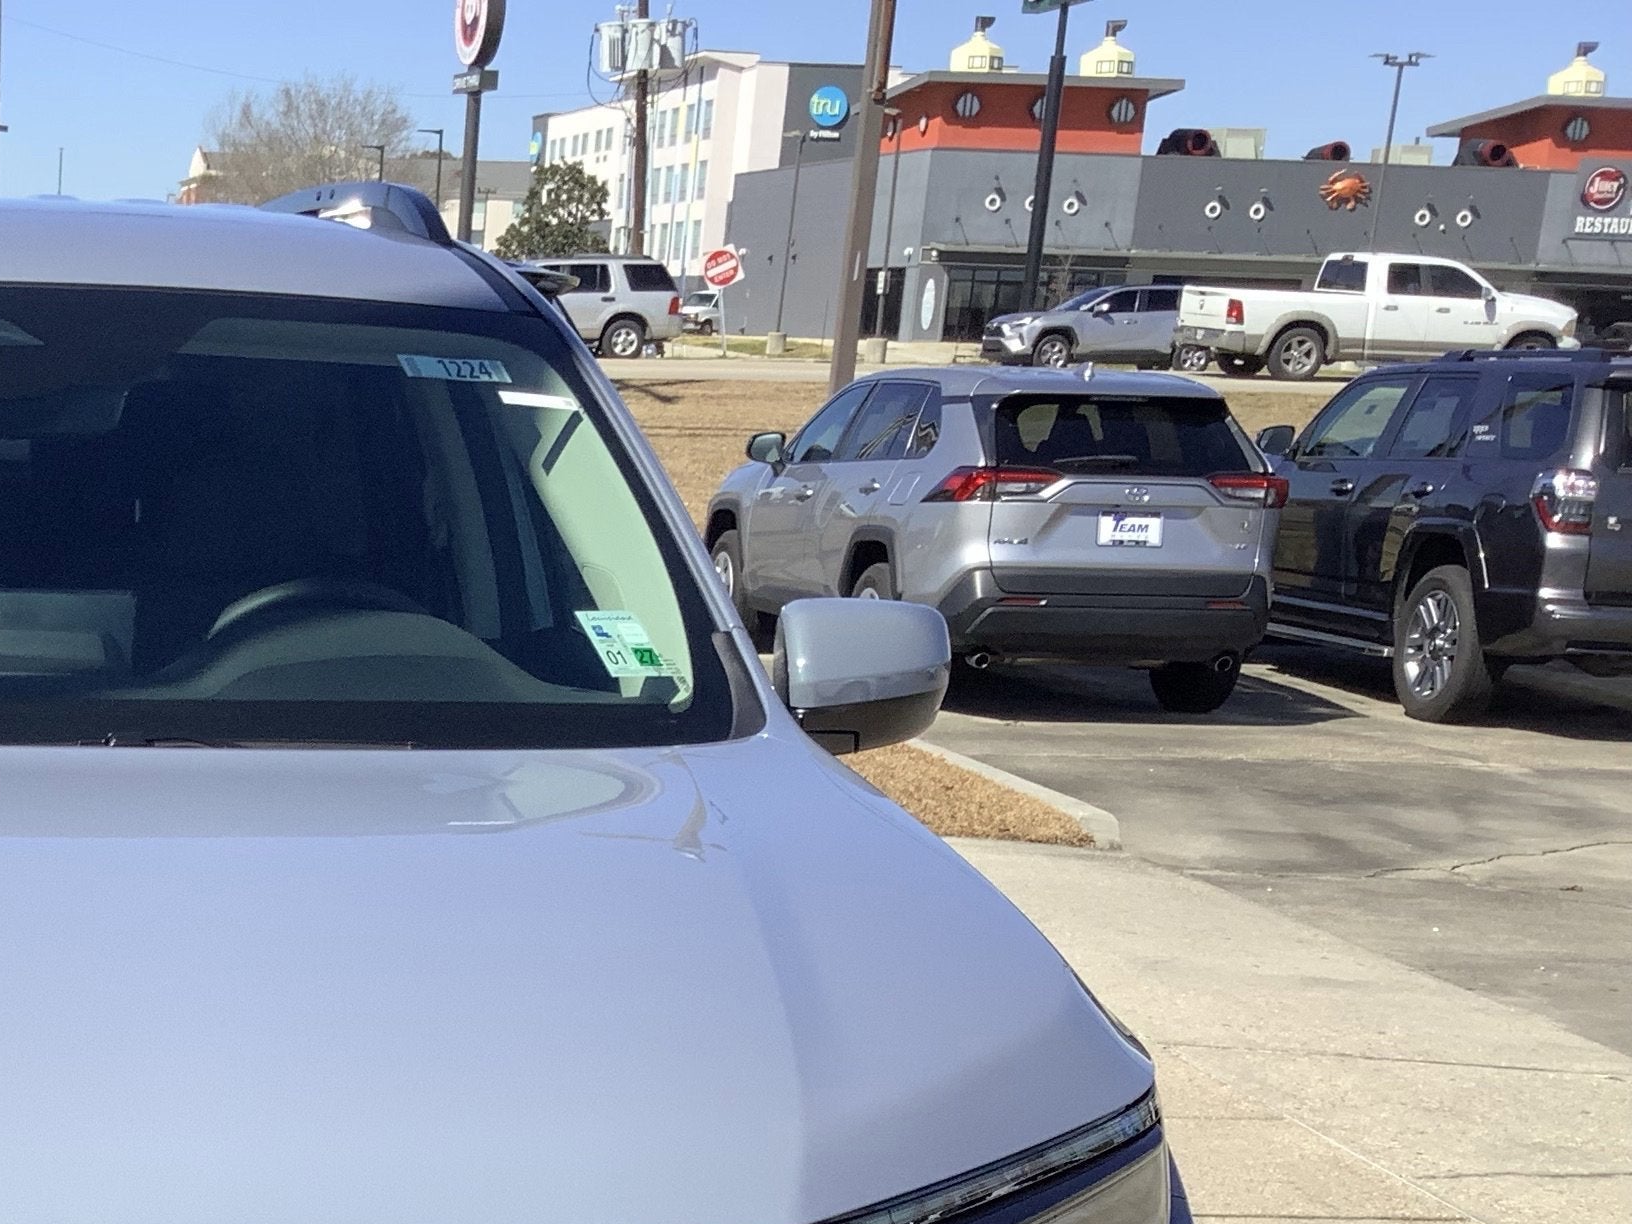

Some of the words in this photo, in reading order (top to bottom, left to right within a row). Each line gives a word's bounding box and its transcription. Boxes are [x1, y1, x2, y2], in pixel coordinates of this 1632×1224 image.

[811, 92, 841, 116] tru
[437, 359, 493, 379] 1224
[606, 650, 628, 665] 01
[634, 649, 655, 664] 27
